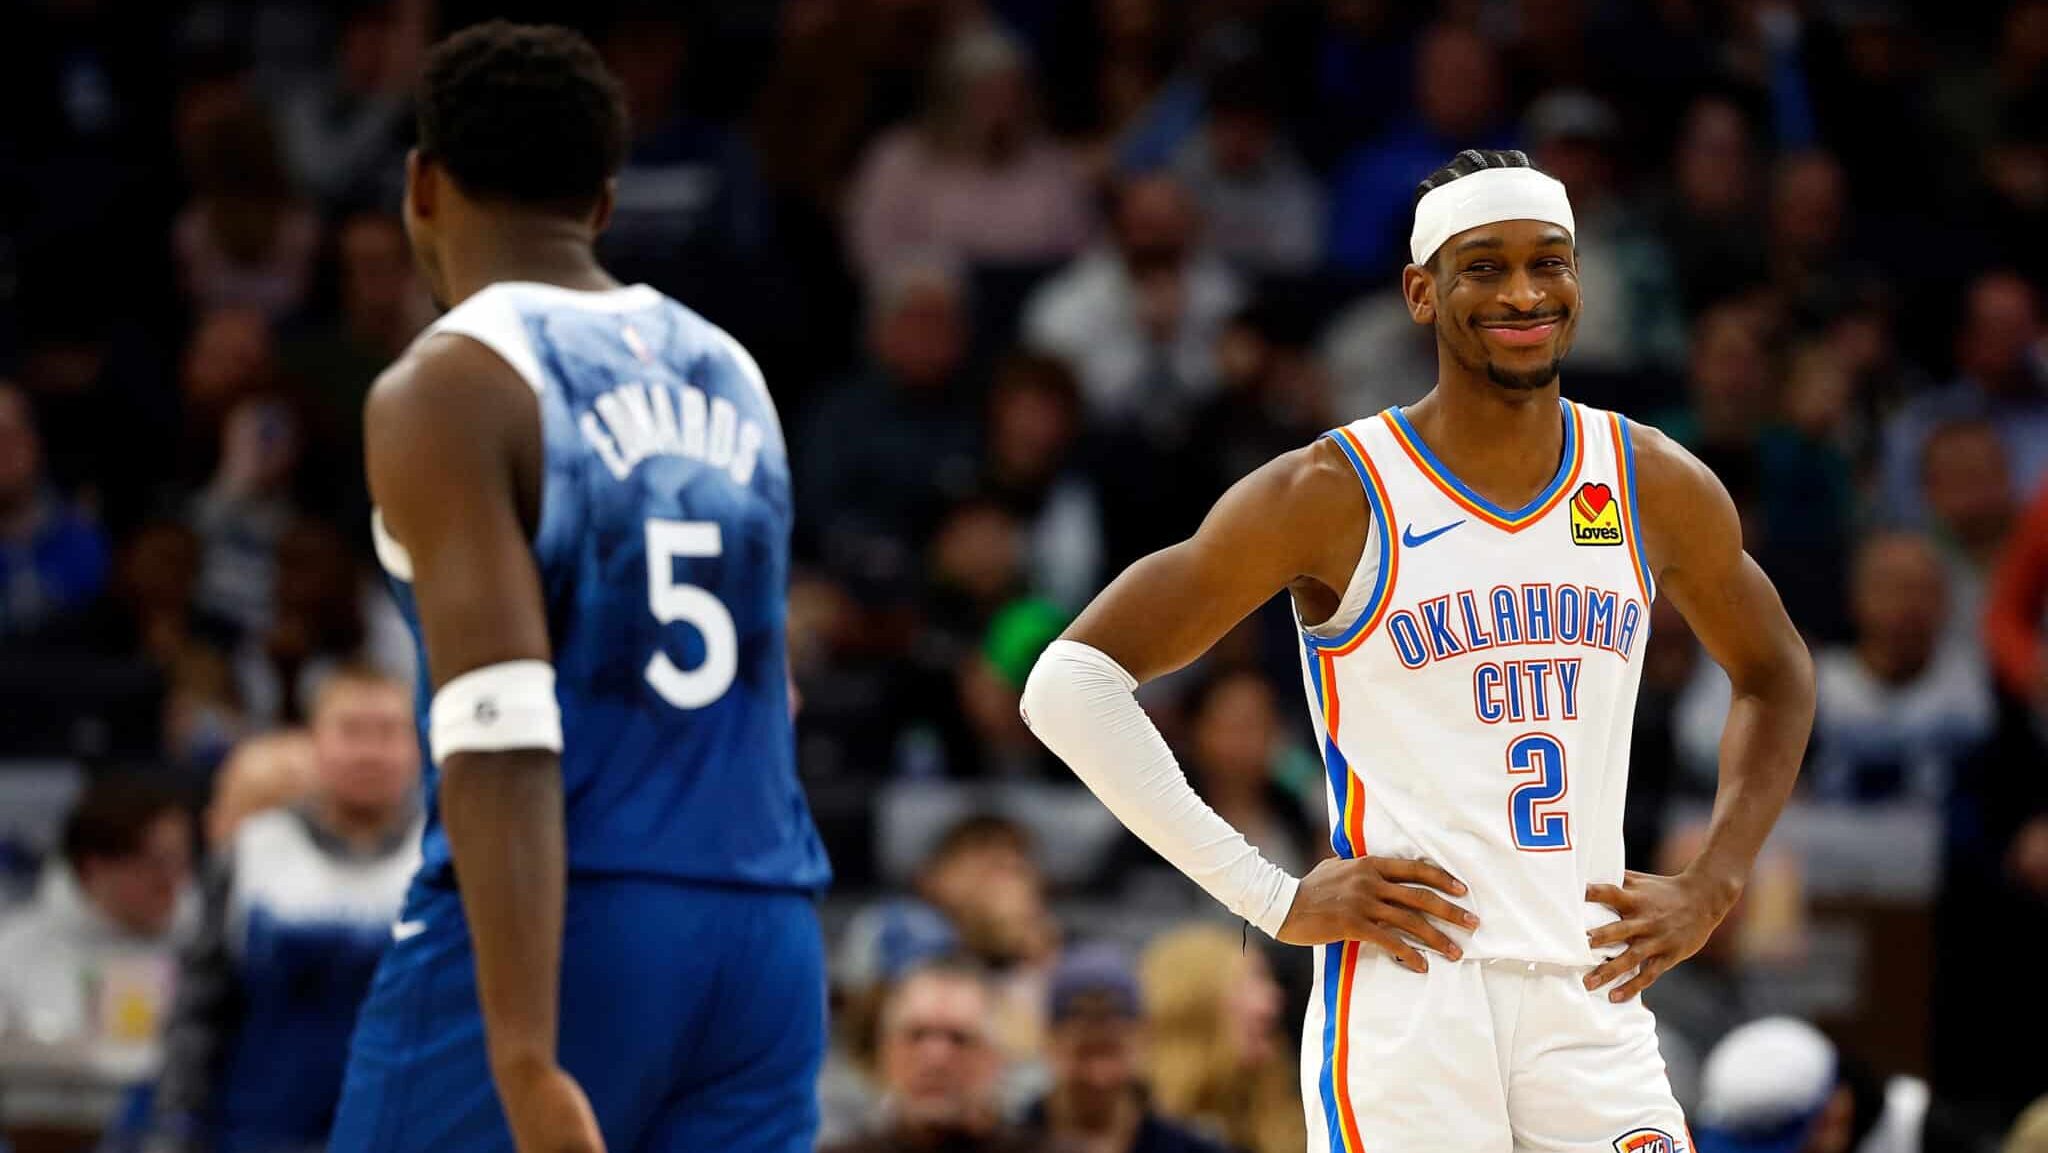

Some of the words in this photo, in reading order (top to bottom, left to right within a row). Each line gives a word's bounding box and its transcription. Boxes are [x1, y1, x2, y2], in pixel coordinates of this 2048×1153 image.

[579, 382, 763, 485] EDWARDS
[644, 517, 739, 710] 5
[1386, 583, 1642, 670] OKLAHOMA
[1473, 658, 1582, 724] CITY
[1506, 731, 1572, 851] 2
